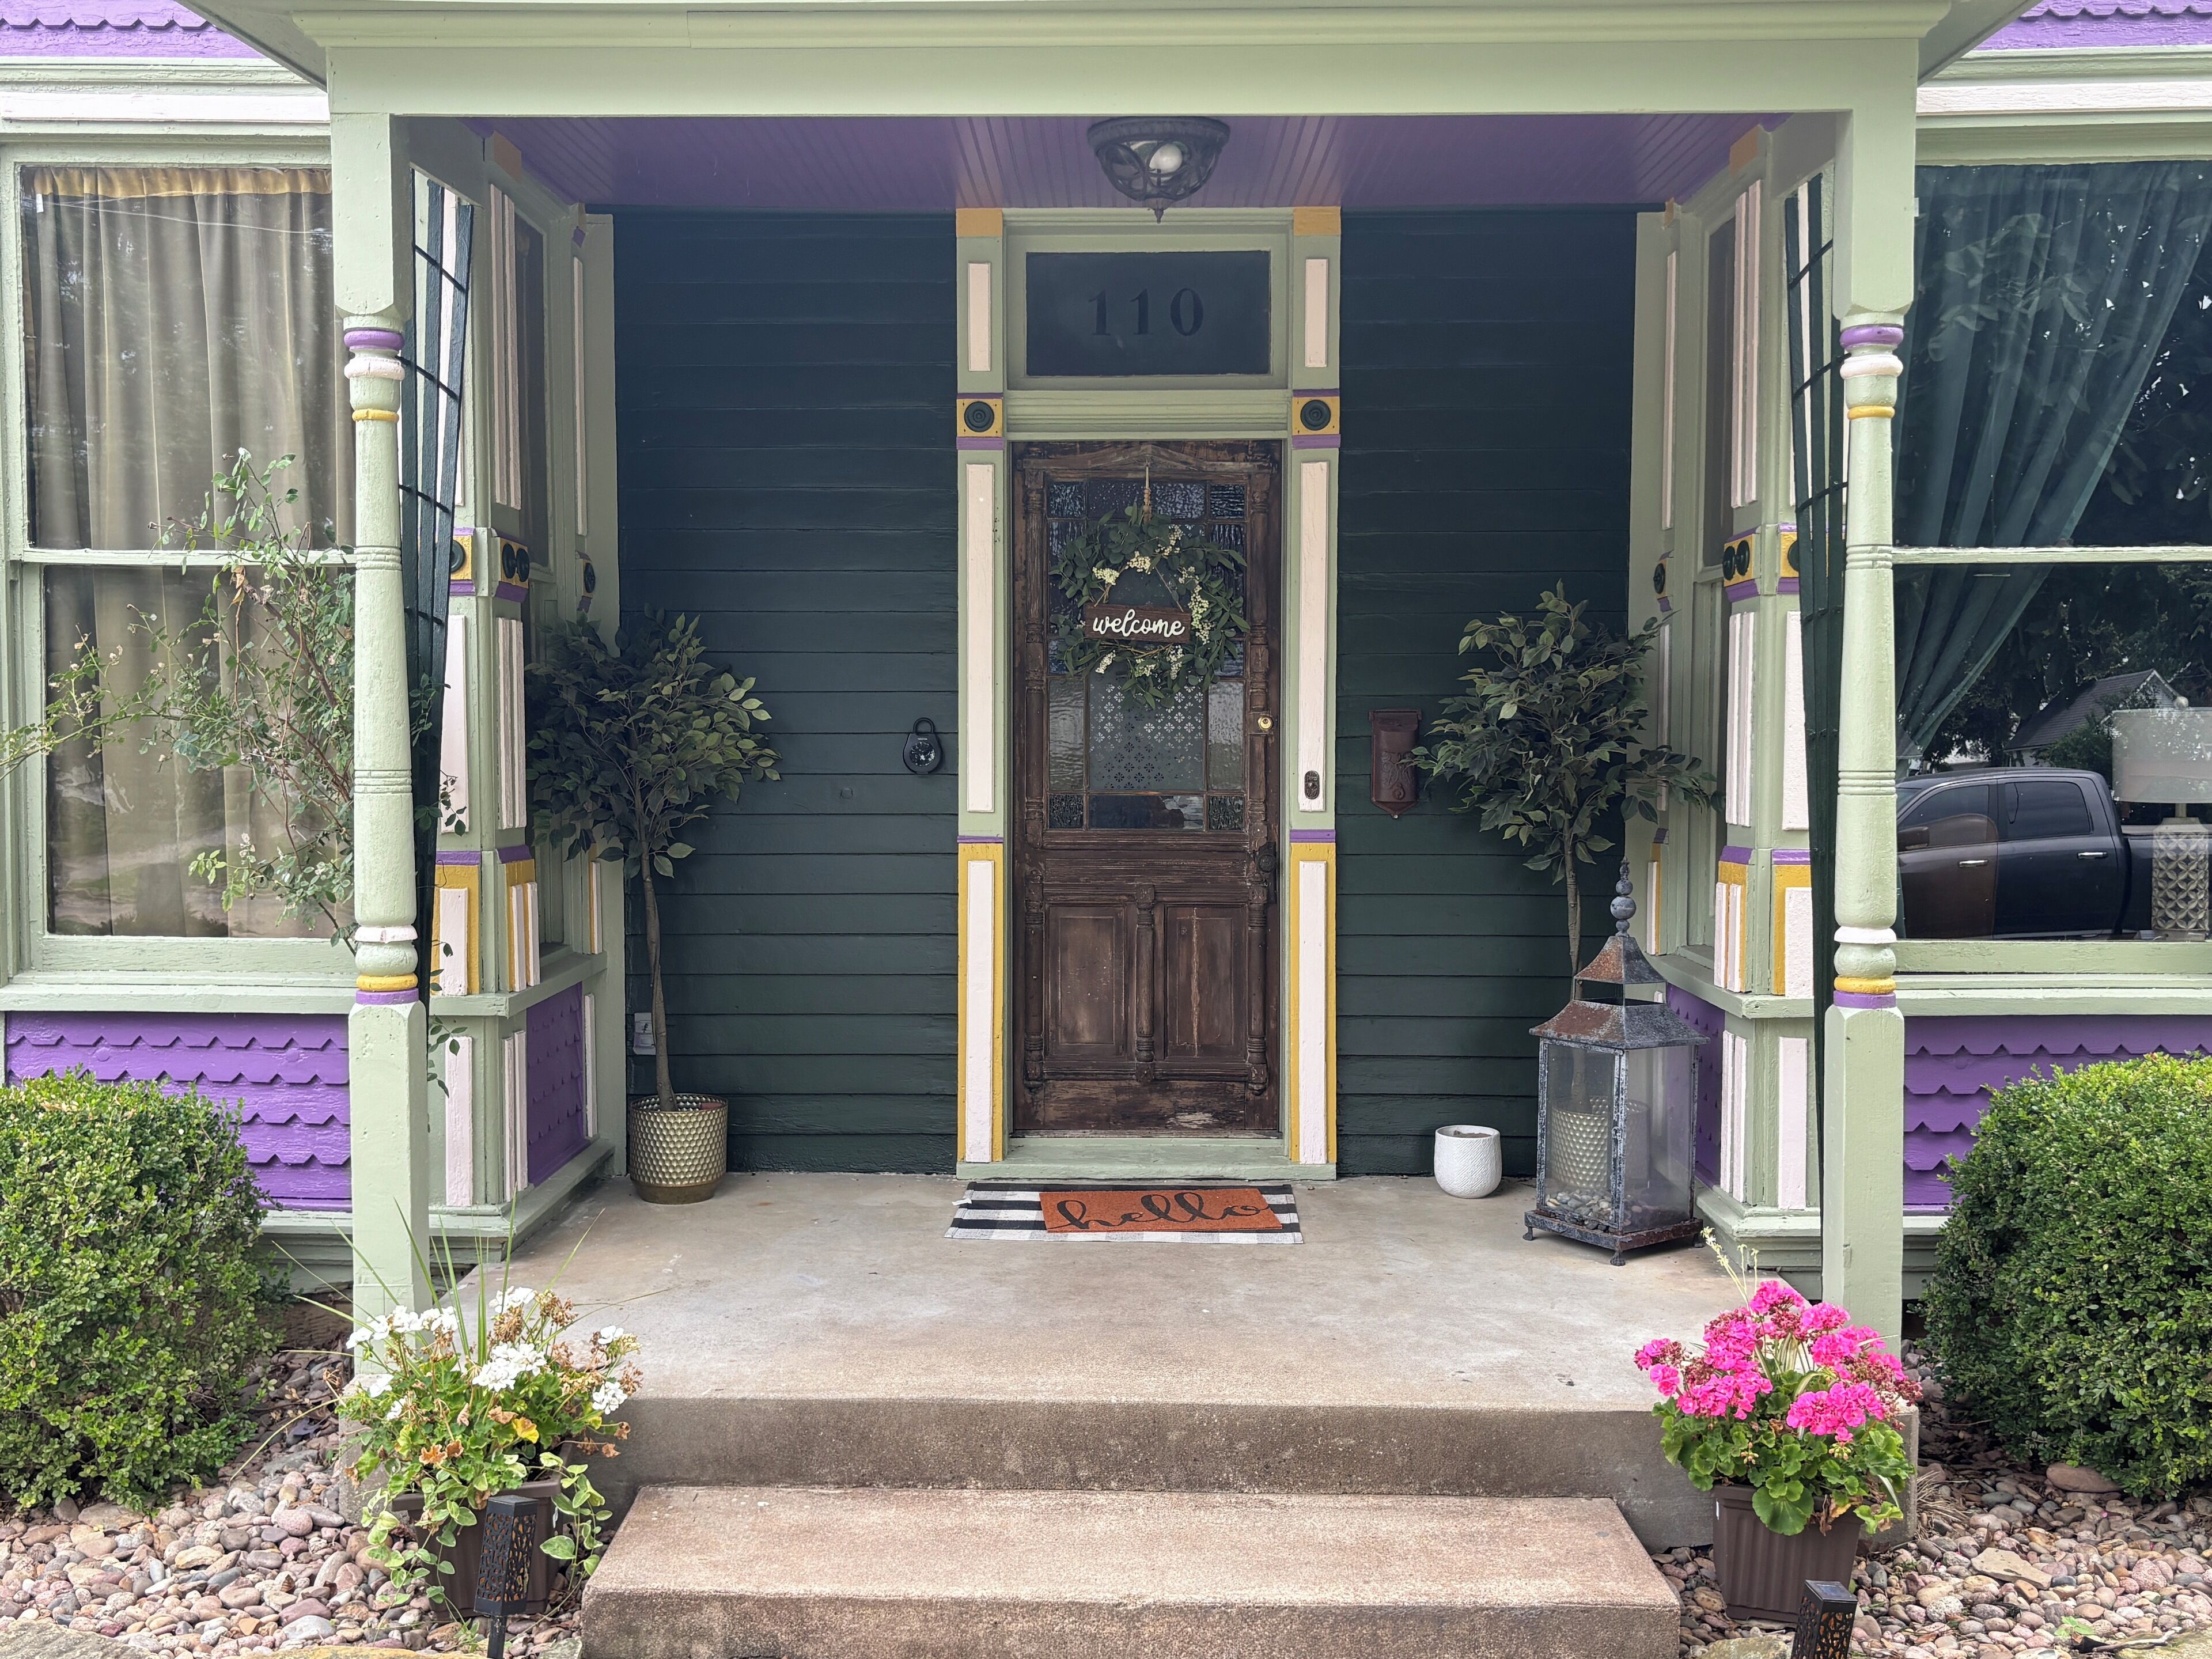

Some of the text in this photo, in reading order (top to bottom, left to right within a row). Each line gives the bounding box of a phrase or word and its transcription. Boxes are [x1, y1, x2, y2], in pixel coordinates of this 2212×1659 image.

[1088, 288, 1204, 336] 110
[1093, 609, 1185, 638] welcome
[1047, 1192, 1270, 1229] hello
